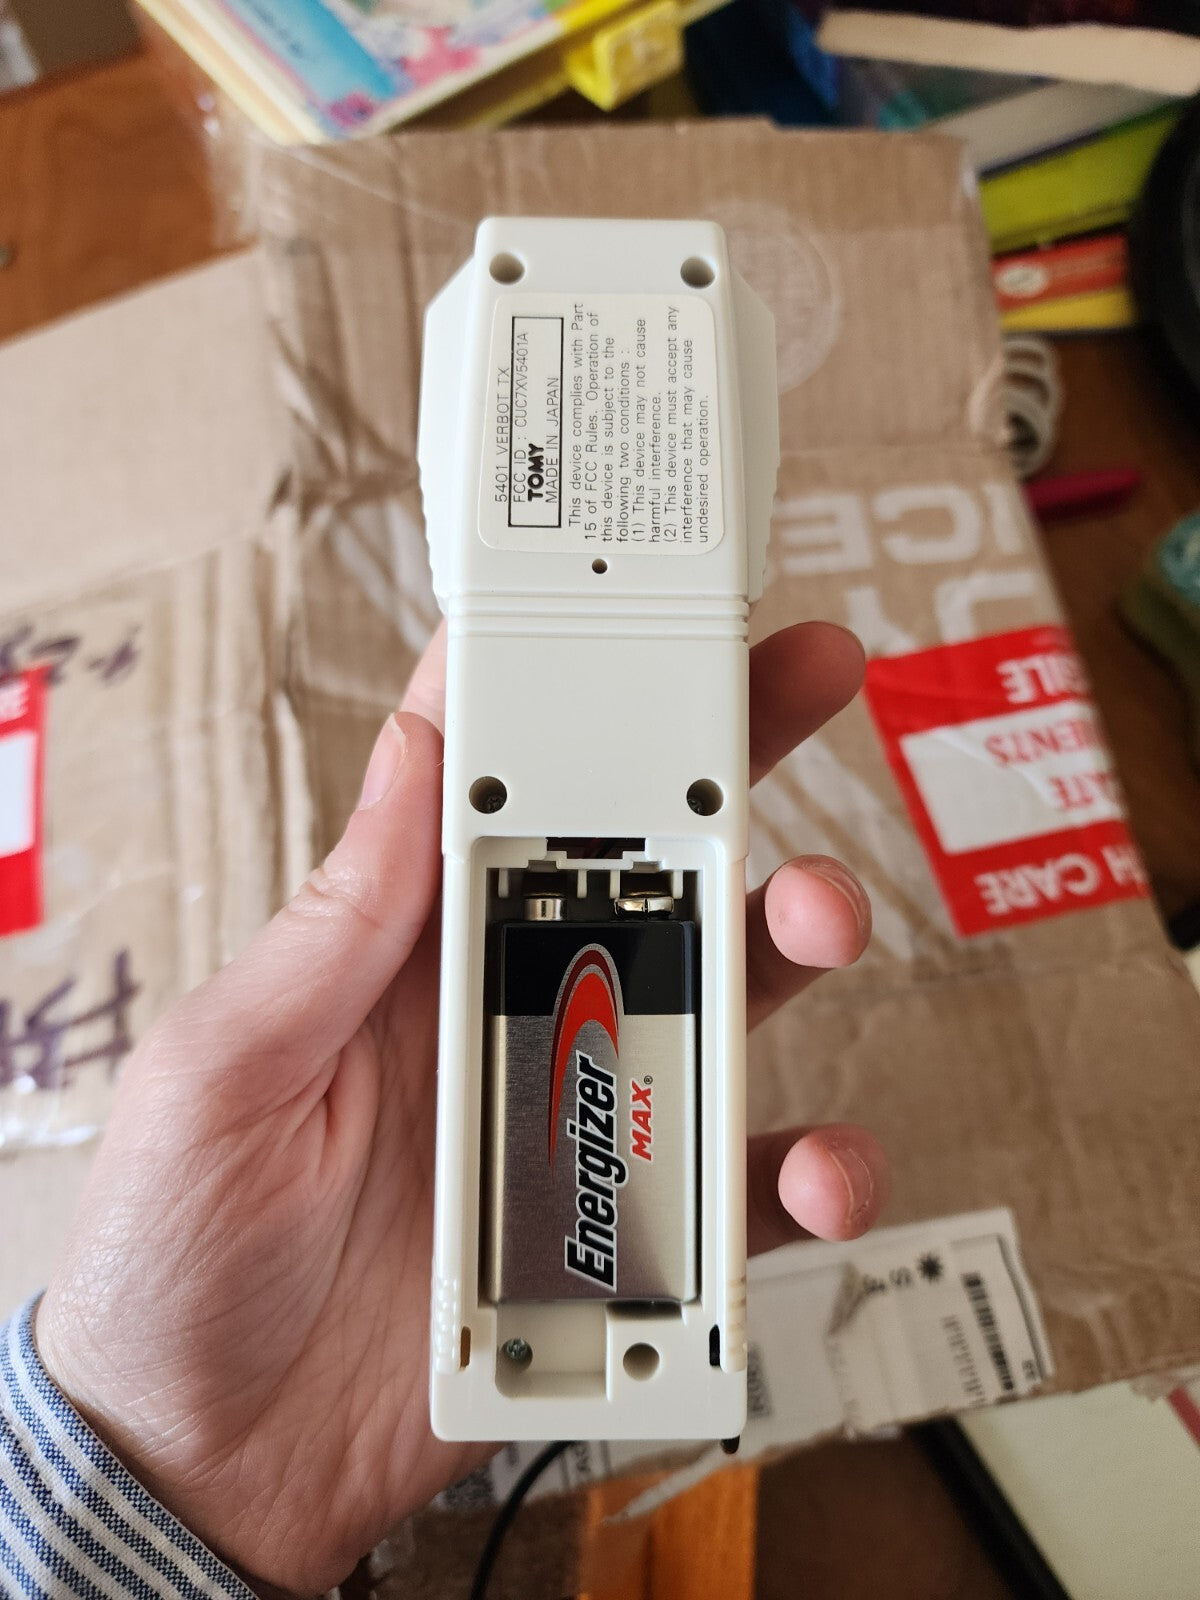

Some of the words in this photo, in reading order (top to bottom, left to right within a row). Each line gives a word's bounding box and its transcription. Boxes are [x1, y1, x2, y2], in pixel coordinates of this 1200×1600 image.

[571, 304, 583, 330] Part
[587, 312, 599, 326] of
[668, 306, 680, 331] any
[570, 339, 583, 368] with
[602, 337, 614, 359] the
[637, 319, 646, 358] cause
[497, 367, 510, 386] TX
[586, 334, 601, 401] Operation
[604, 366, 614, 380] to
[636, 364, 646, 388] not
[668, 337, 679, 383] accept
[684, 339, 692, 379] cause
[514, 332, 528, 427] CUC7XV5401A
[546, 377, 559, 427] JAPAN
[570, 375, 584, 437] complies
[602, 387, 616, 438] subject
[617, 362, 630, 434] conditions
[636, 395, 648, 424] may
[667, 390, 677, 425] must
[683, 386, 695, 416] may
[496, 393, 509, 455] VERBOT
[546, 434, 558, 450] IN
[585, 410, 598, 453] Rules.
[648, 392, 661, 480] interference.
[681, 422, 693, 450] that
[697, 395, 711, 466] operation.
[514, 449, 526, 464] ID
[569, 444, 582, 490] device
[601, 445, 613, 455] is
[620, 441, 629, 468] two
[633, 432, 645, 477] device
[664, 432, 677, 478] device
[494, 466, 508, 502] 5401
[513, 473, 526, 502] FCC
[527, 443, 544, 502] TOMY
[545, 458, 558, 503] MADE
[585, 461, 598, 491] FCC
[600, 463, 613, 509] device
[568, 498, 581, 527] This
[585, 499, 597, 514] of
[616, 476, 631, 542] following
[632, 485, 645, 514] This
[648, 488, 660, 543] harmful
[664, 485, 676, 515] This
[680, 458, 692, 543] interference
[697, 474, 709, 543] undesired
[584, 522, 597, 539] 15
[601, 516, 613, 542] this
[631, 522, 645, 542] (1)
[663, 523, 677, 542] (2)
[984, 718, 1106, 768] ENTS
[974, 853, 1101, 916] CARE
[565, 1049, 628, 1292] Energizer
